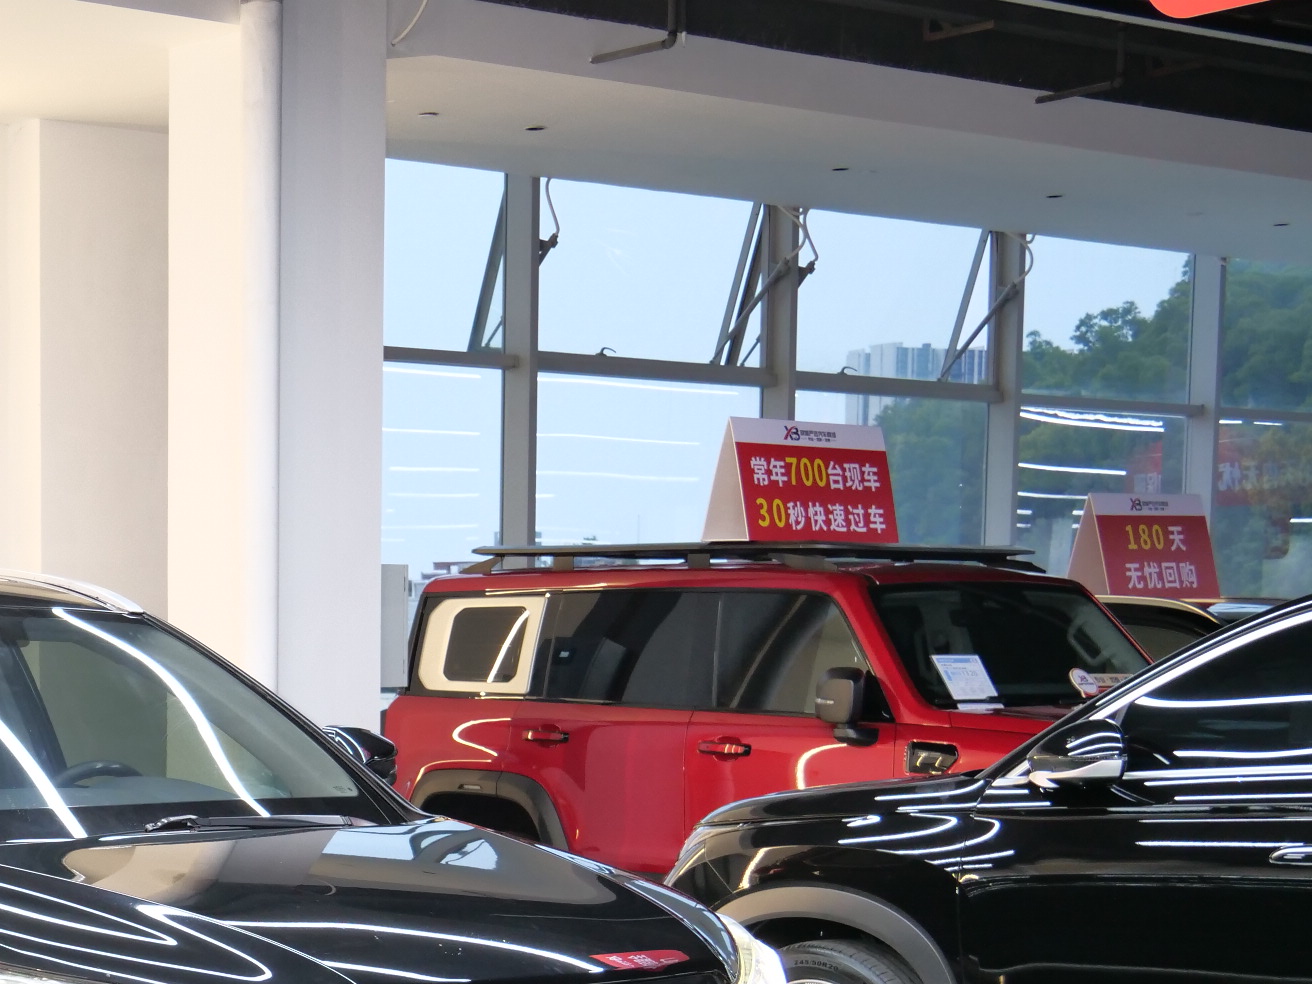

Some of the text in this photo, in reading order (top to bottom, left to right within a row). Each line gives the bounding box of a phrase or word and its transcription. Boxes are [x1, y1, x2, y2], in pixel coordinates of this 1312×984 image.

[750, 456, 881, 492] 常年700台现车
[755, 497, 887, 535] 30秒快速过车
[1125, 524, 1187, 552] 180天
[1125, 561, 1198, 589] 无忧回购
